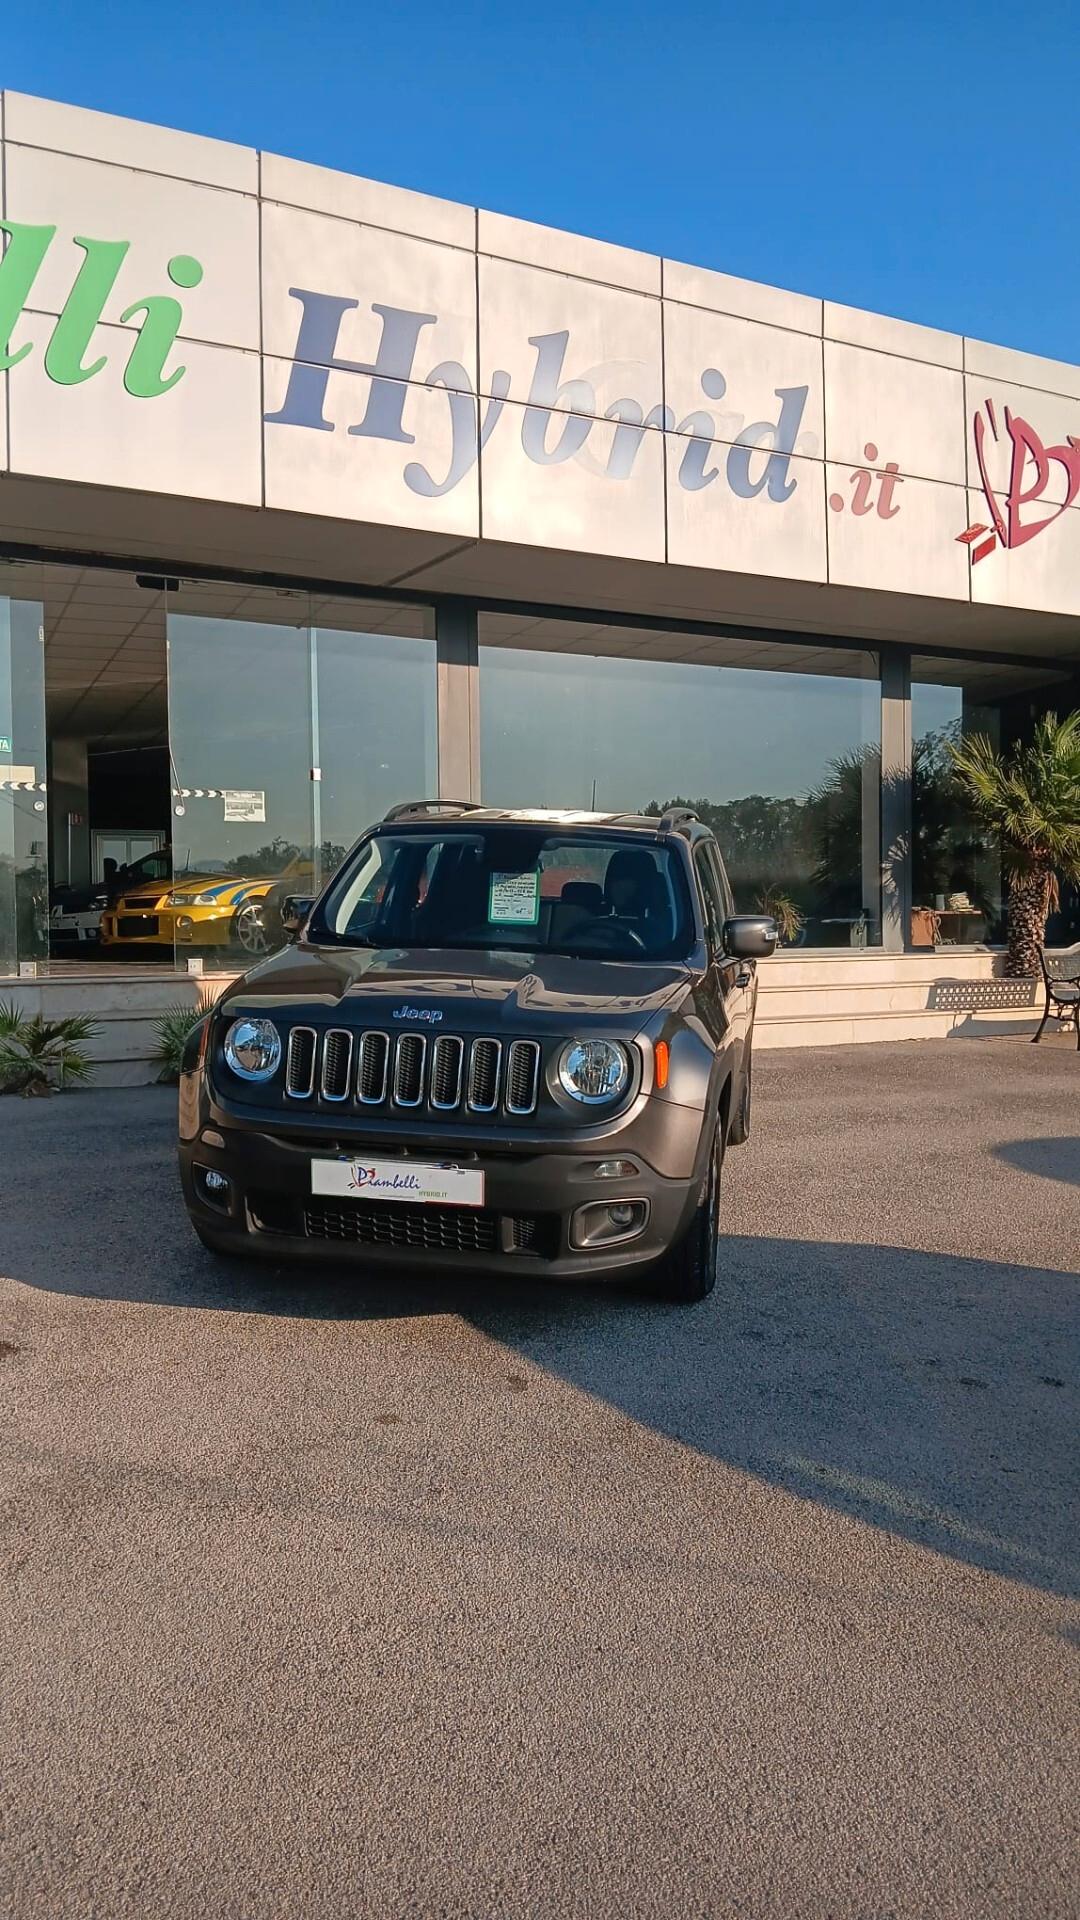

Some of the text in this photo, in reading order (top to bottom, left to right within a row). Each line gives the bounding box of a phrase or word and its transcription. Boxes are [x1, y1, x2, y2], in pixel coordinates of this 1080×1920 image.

[264, 287, 904, 519] Hybrid .it
[393, 1005, 443, 1024] Jeep
[357, 1166, 421, 1190] Piambelli
